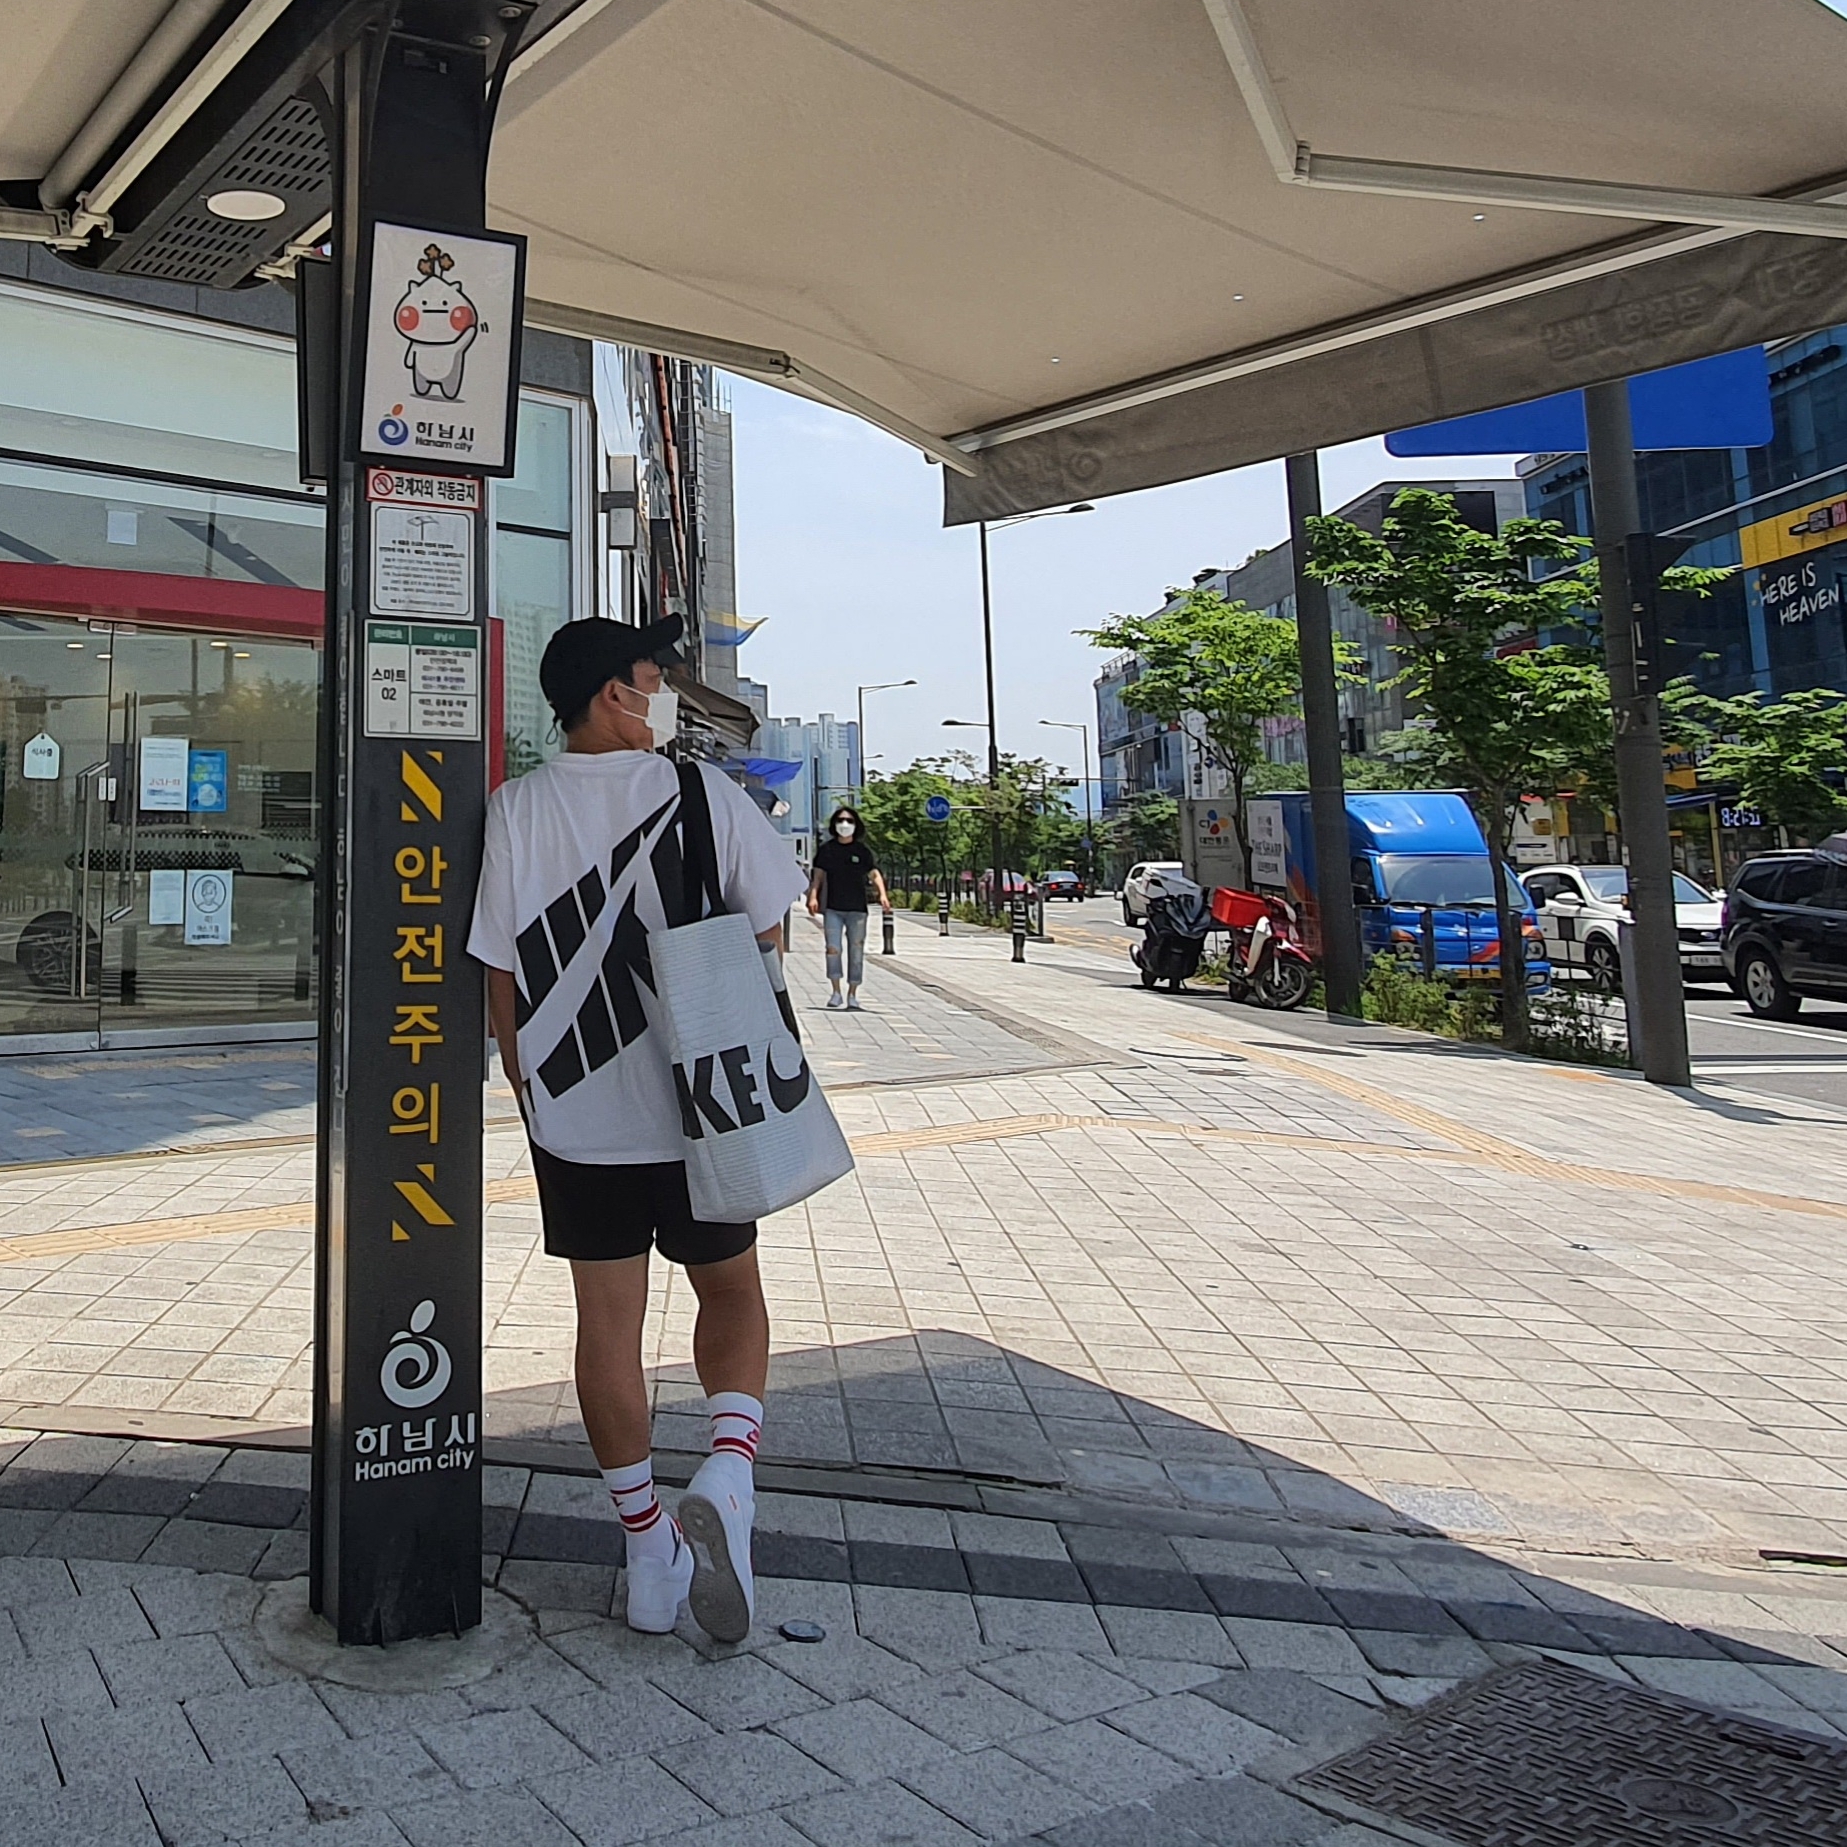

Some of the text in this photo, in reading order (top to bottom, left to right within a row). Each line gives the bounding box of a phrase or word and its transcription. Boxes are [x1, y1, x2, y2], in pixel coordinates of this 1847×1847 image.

[416, 421, 475, 441] 하남시
[415, 436, 473, 453] Hanam city
[395, 476, 475, 502] 관계자외 작동금지
[1760, 561, 1816, 607] HERE IS
[1779, 583, 1839, 626] HEAVEN
[371, 667, 407, 683] 스마트
[381, 687, 397, 701] 02
[1199, 819, 1211, 830] CJ
[388, 845, 449, 1145] 안전주의
[354, 1412, 476, 1457] 하남시
[355, 1447, 475, 1482] Hanam city
